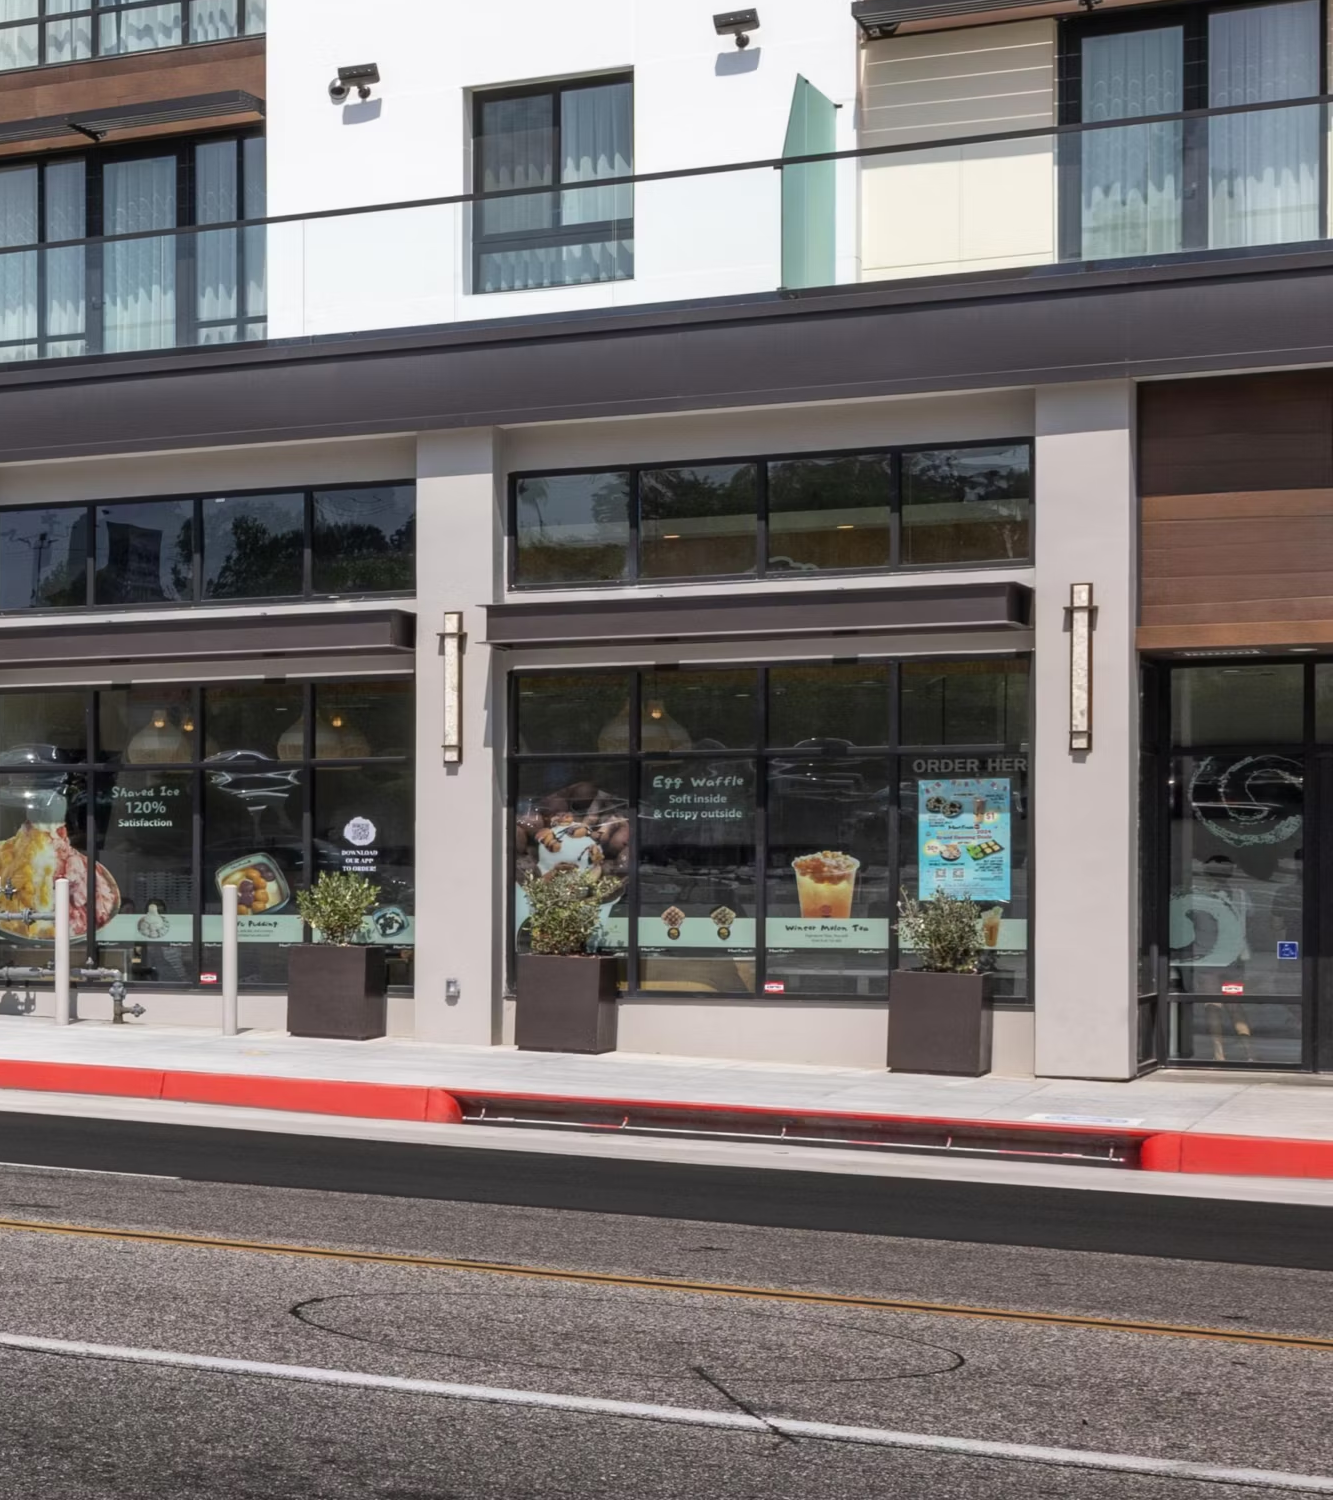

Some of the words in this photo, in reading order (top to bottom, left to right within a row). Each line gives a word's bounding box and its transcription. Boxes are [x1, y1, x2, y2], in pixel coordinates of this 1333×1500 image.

[913, 758, 979, 773] ORDER
[988, 758, 1029, 772] HER
[652, 775, 684, 790] Egg
[690, 776, 745, 787] Waffle
[111, 786, 155, 798] Shaved
[160, 786, 180, 796] Ice
[668, 794, 692, 804] Soft
[693, 794, 728, 804] inside
[125, 801, 167, 814] 120%
[653, 809, 662, 819] &
[664, 808, 699, 821] Crispy
[700, 808, 743, 819] outside
[118, 818, 173, 828] Satisfaction
[248, 920, 278, 928] Pudding
[785, 924, 816, 932] Winter
[820, 924, 848, 932] Melon
[852, 924, 869, 932] Tea
